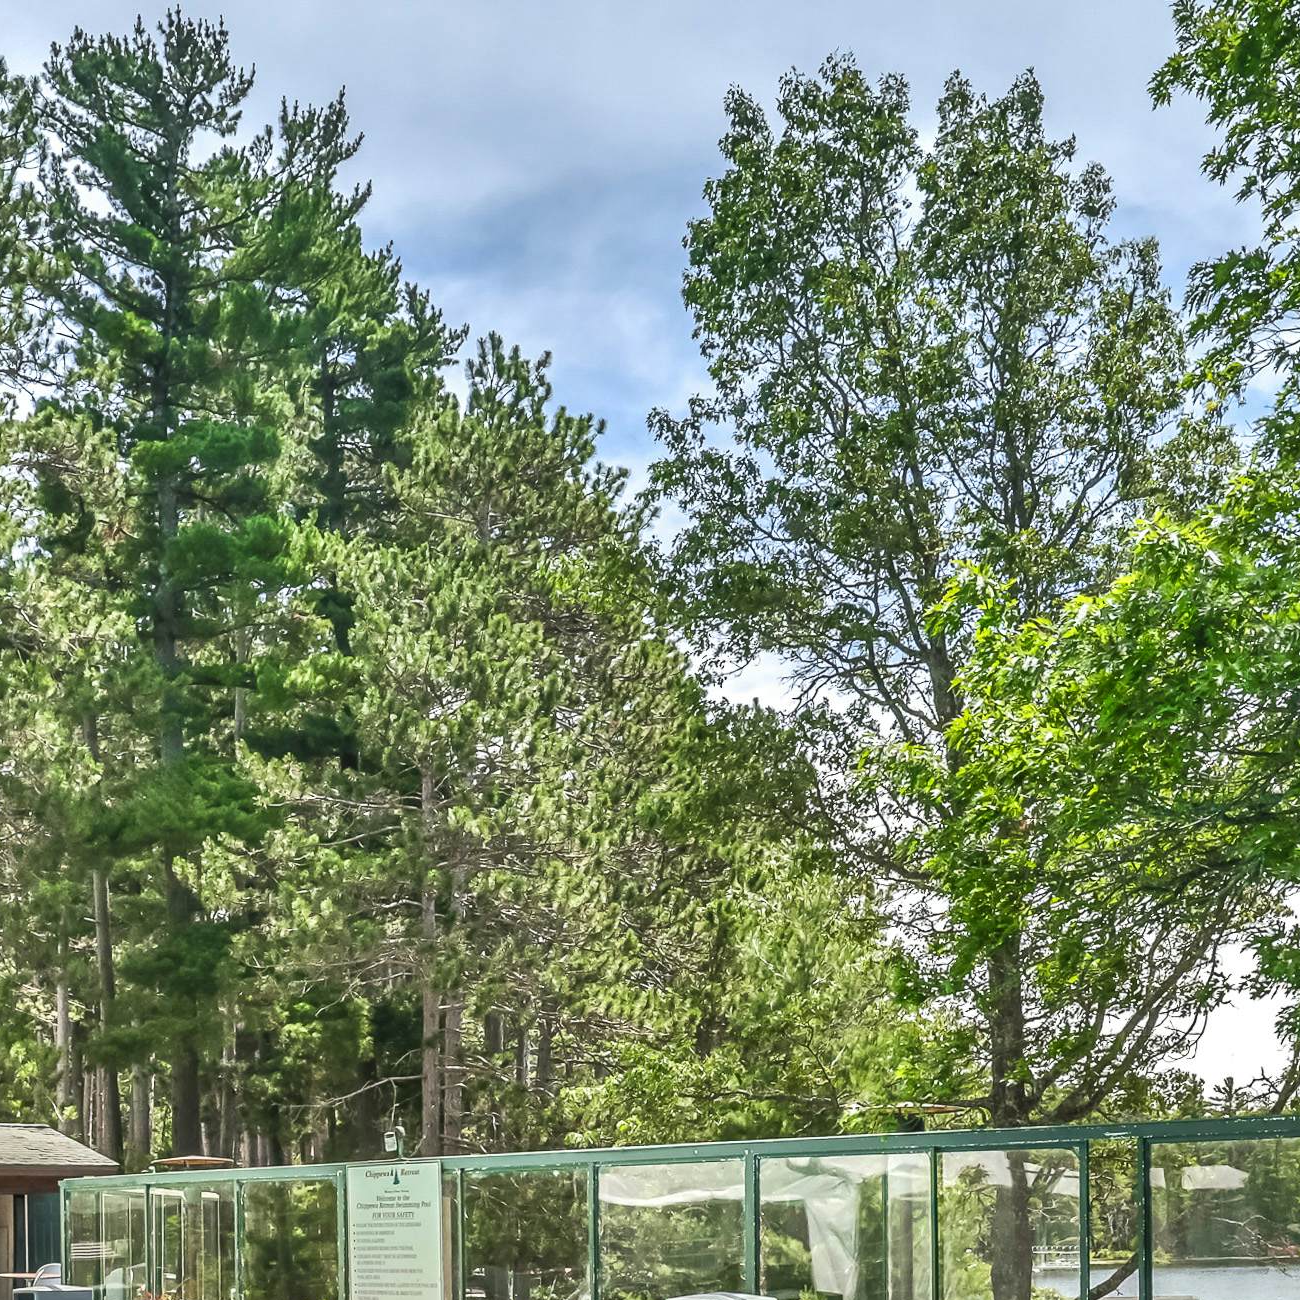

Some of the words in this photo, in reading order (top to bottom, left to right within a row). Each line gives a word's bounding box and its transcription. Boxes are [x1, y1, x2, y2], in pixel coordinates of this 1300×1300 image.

[365, 1170, 390, 1180] Chippewa
[401, 1168, 420, 1176] Retreat
[356, 1202, 378, 1210] Chippewa
